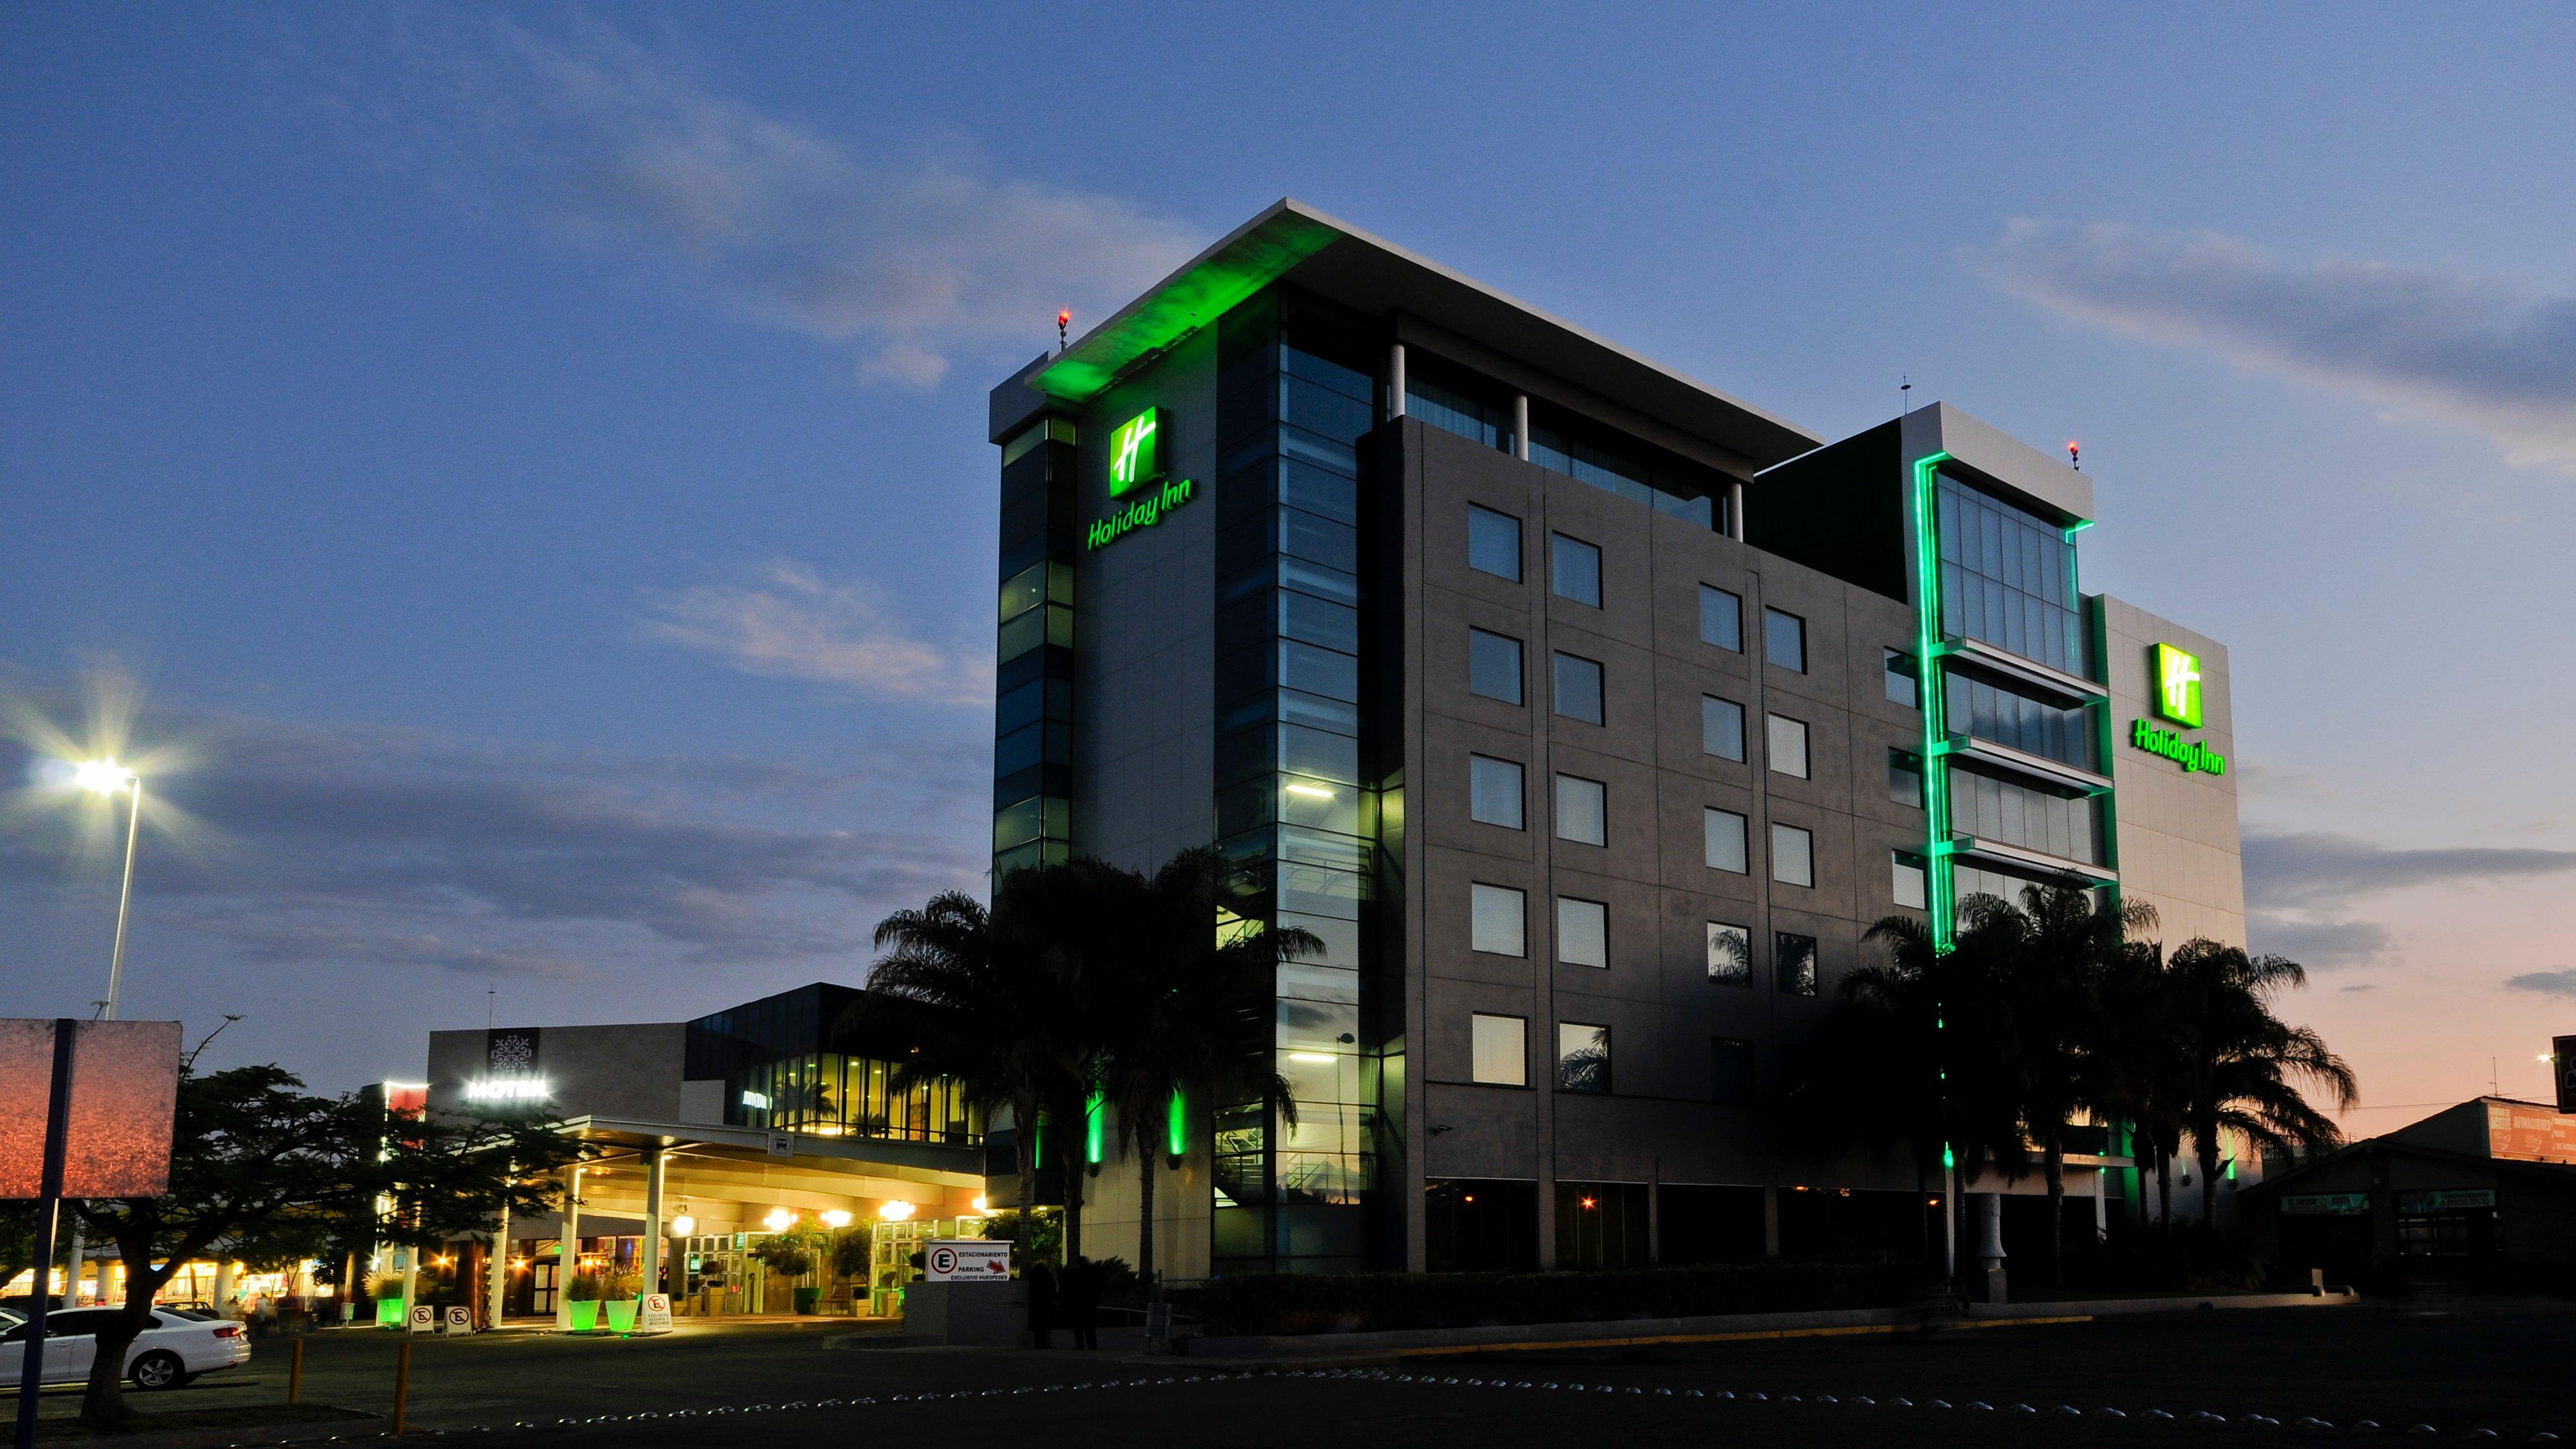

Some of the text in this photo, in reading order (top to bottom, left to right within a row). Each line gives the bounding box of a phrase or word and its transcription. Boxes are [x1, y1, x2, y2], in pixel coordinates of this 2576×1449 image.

[1087, 479, 1192, 550] Holiday Inn
[2135, 718, 2225, 775] Holiday Inn
[938, 1254, 951, 1268] E
